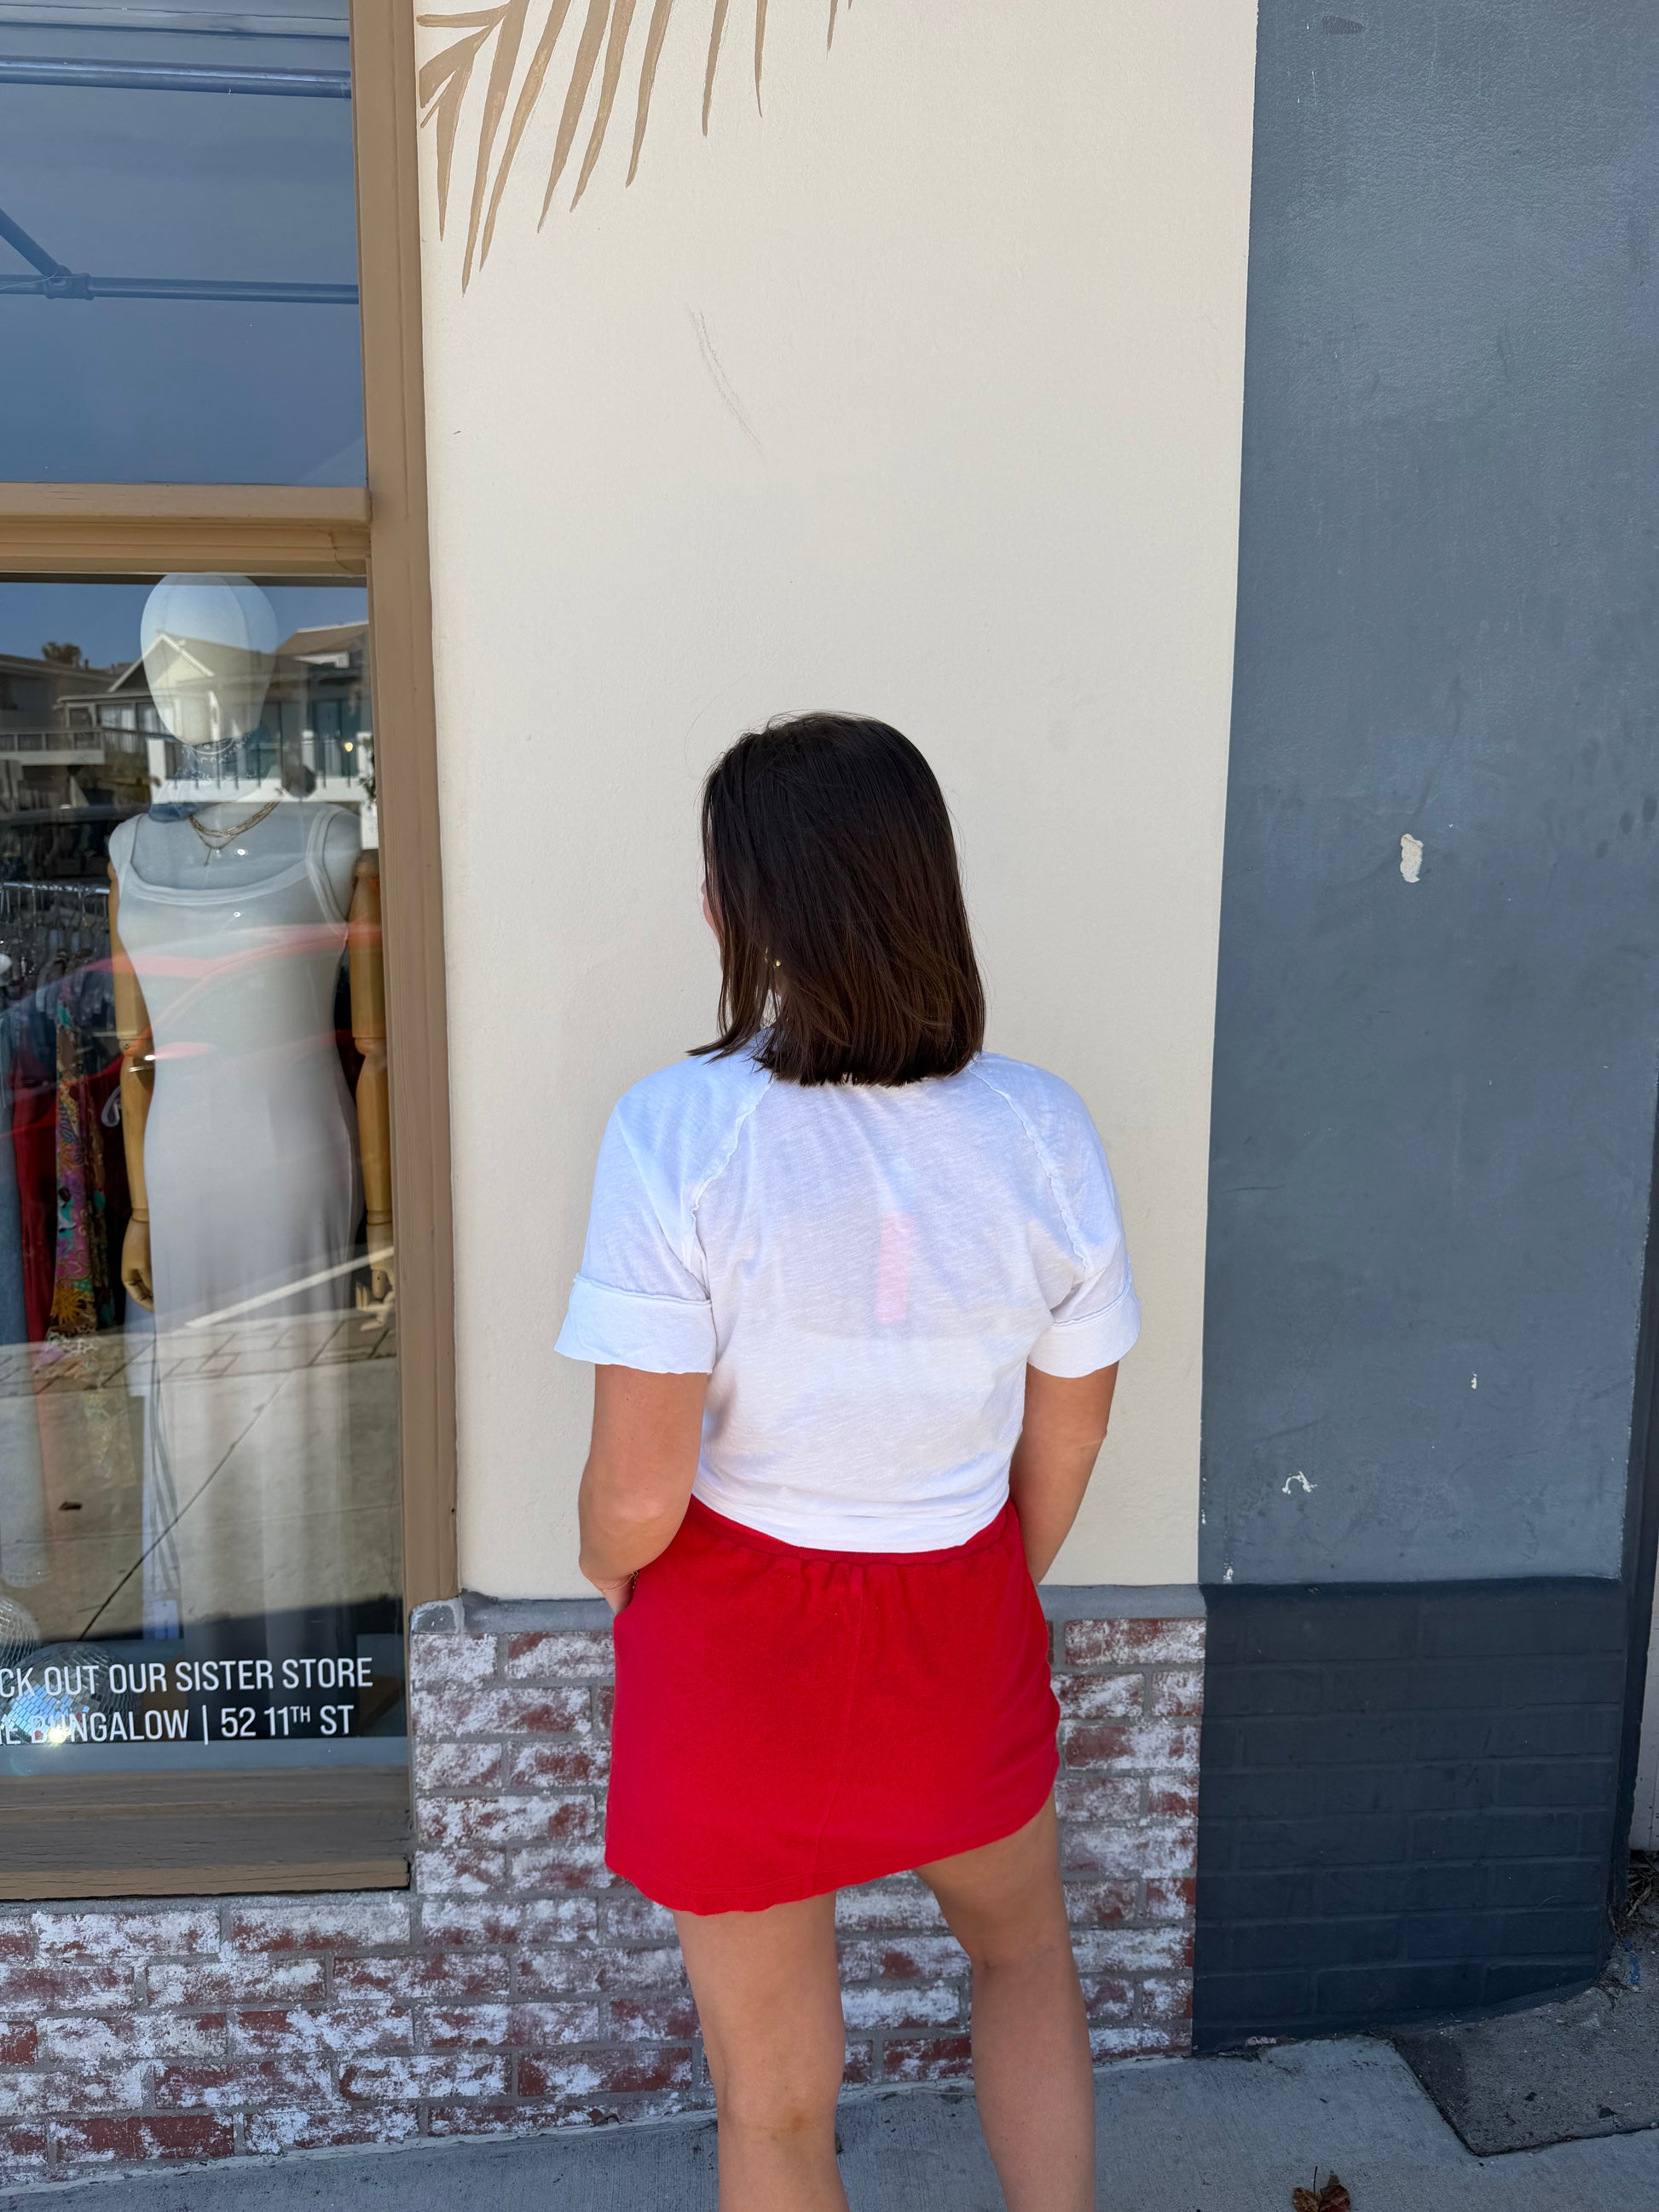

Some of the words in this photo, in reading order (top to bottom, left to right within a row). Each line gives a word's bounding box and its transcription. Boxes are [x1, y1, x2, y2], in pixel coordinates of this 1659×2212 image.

[44, 1665, 99, 1695] OUT
[109, 1662, 167, 1694] OUR
[176, 1659, 274, 1692] SISTER
[282, 1657, 373, 1689] STORE
[0, 1714, 21, 1745] E
[221, 1707, 257, 1738] 52
[264, 1706, 311, 1736] 11TH
[320, 1705, 355, 1735] ST
